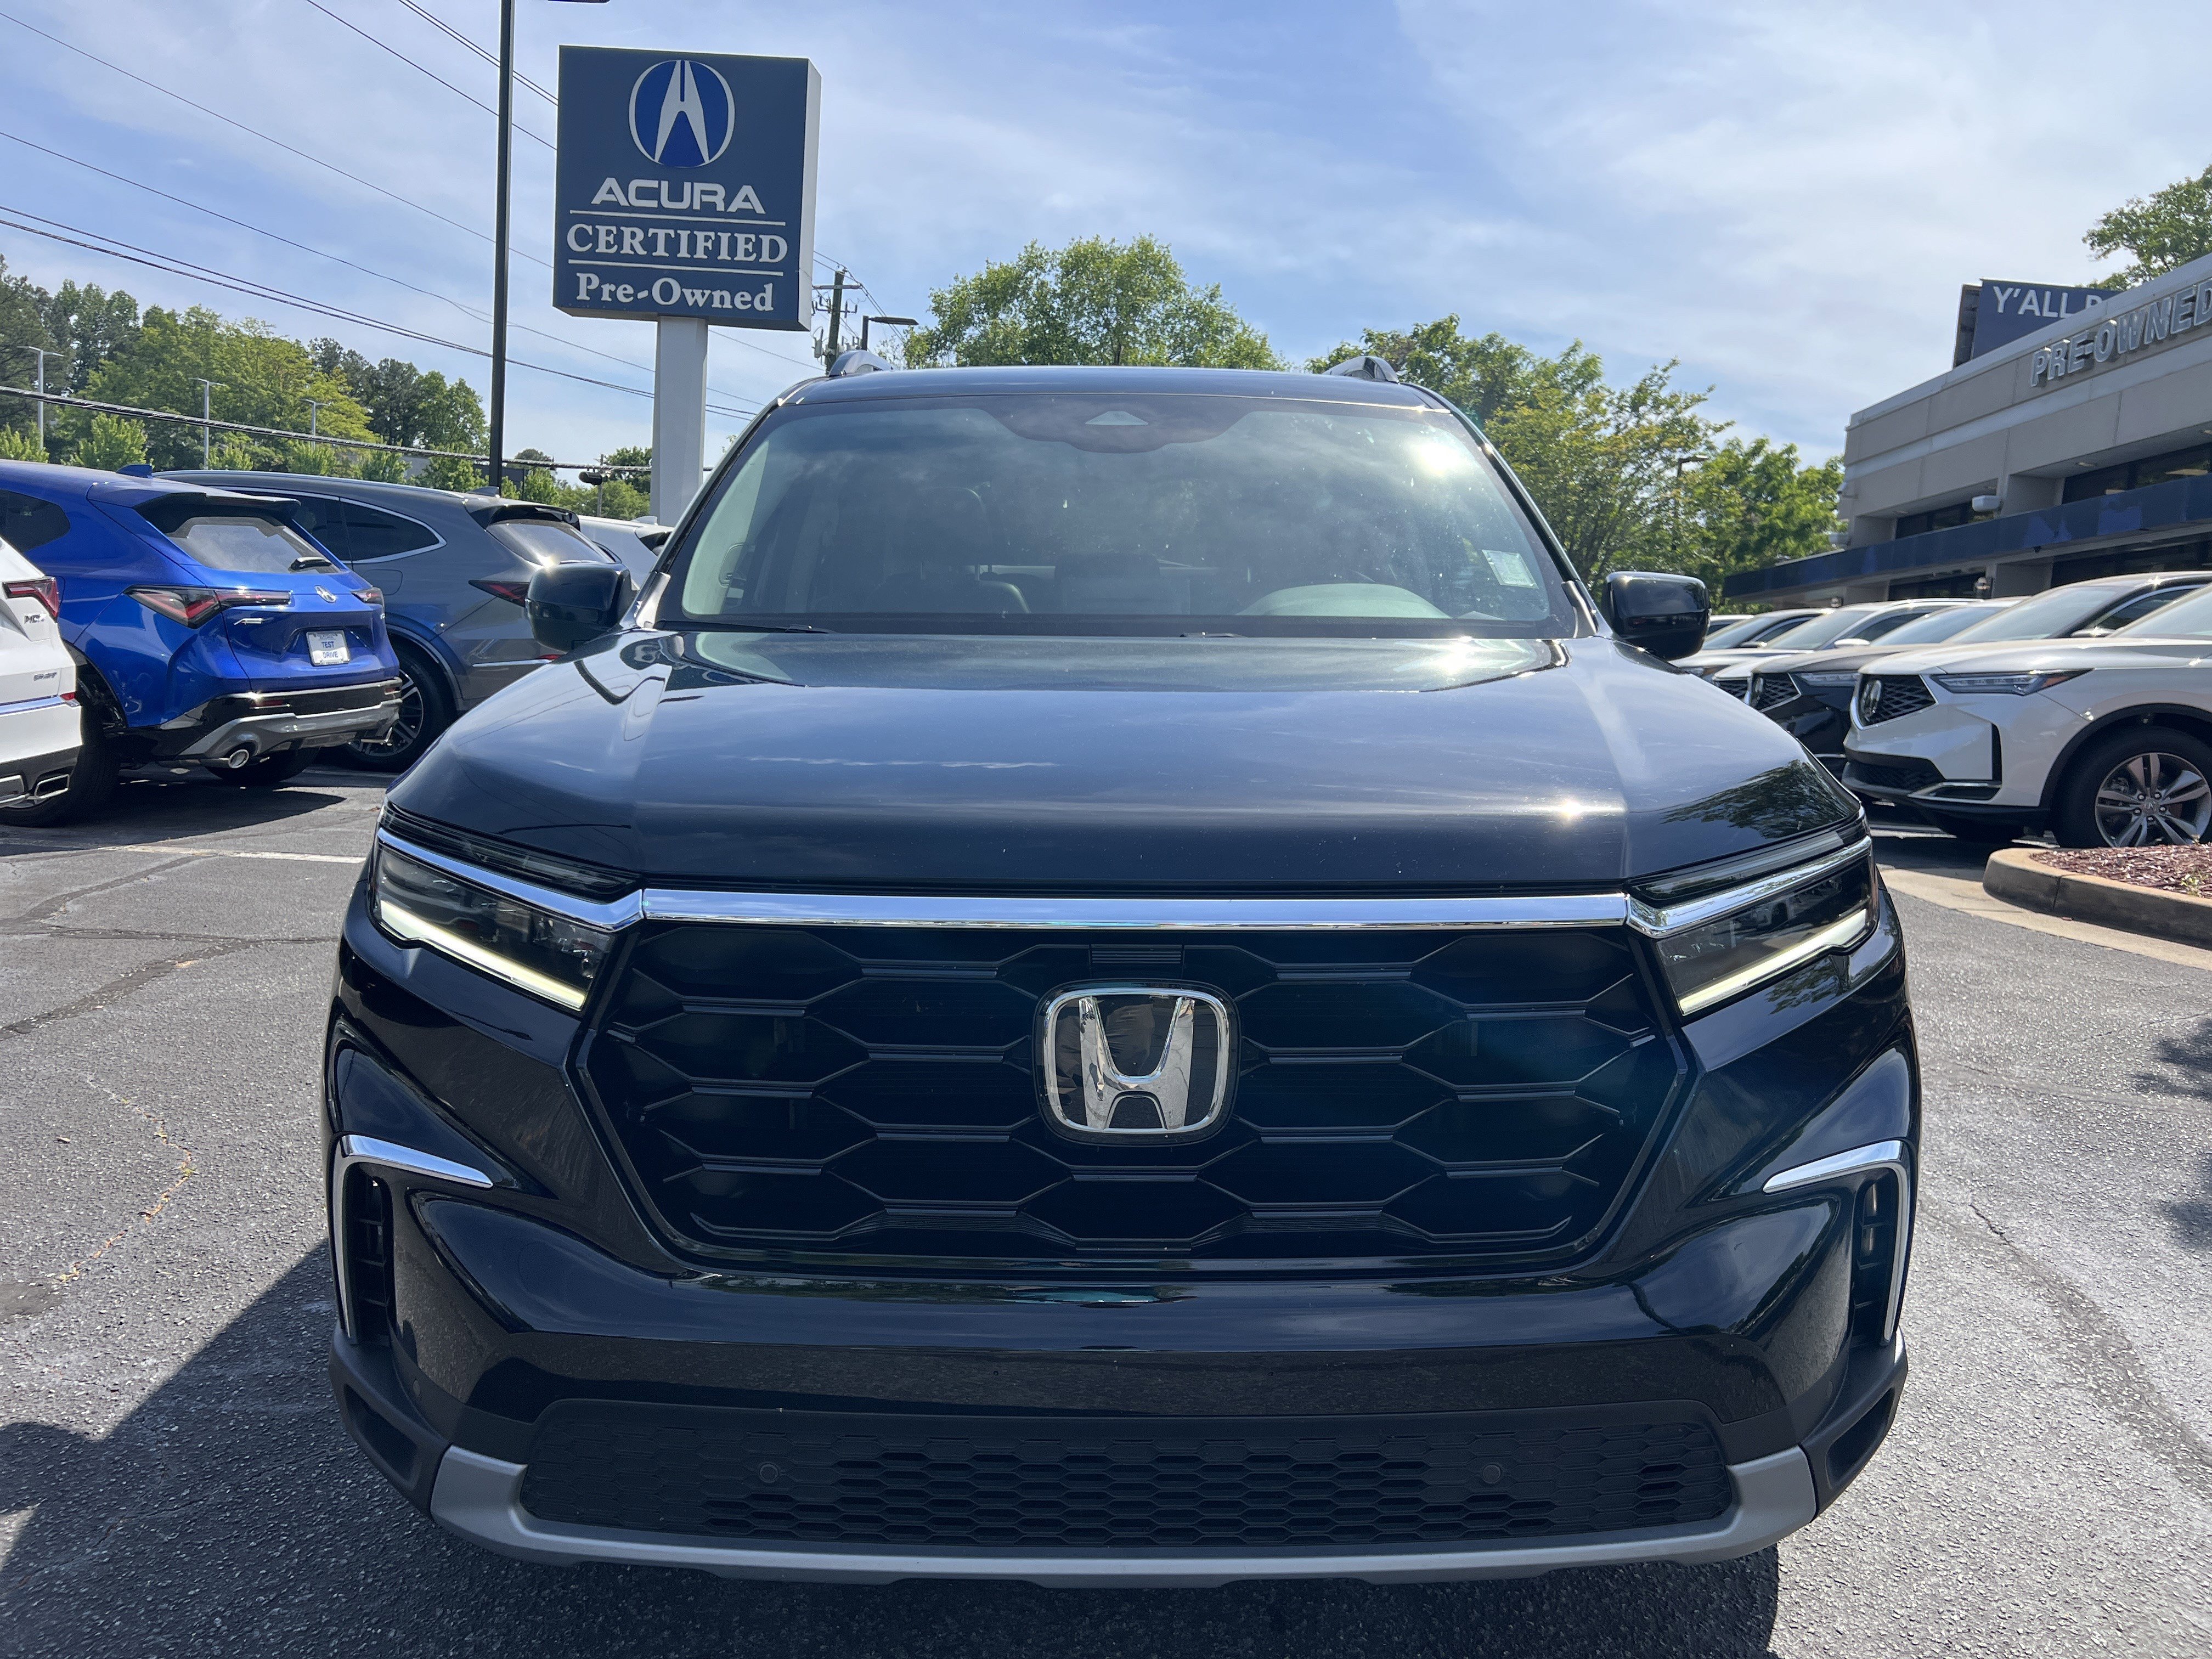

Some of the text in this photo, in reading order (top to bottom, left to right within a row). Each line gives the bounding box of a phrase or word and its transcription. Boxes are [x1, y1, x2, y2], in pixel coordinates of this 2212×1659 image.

[590, 177, 766, 215] ACURA
[566, 223, 788, 263] CERTIFIED
[575, 272, 774, 312] Pre-Owned
[1993, 286, 2077, 319] Y'ALL
[2030, 278, 2212, 387] PRE-OWNED
